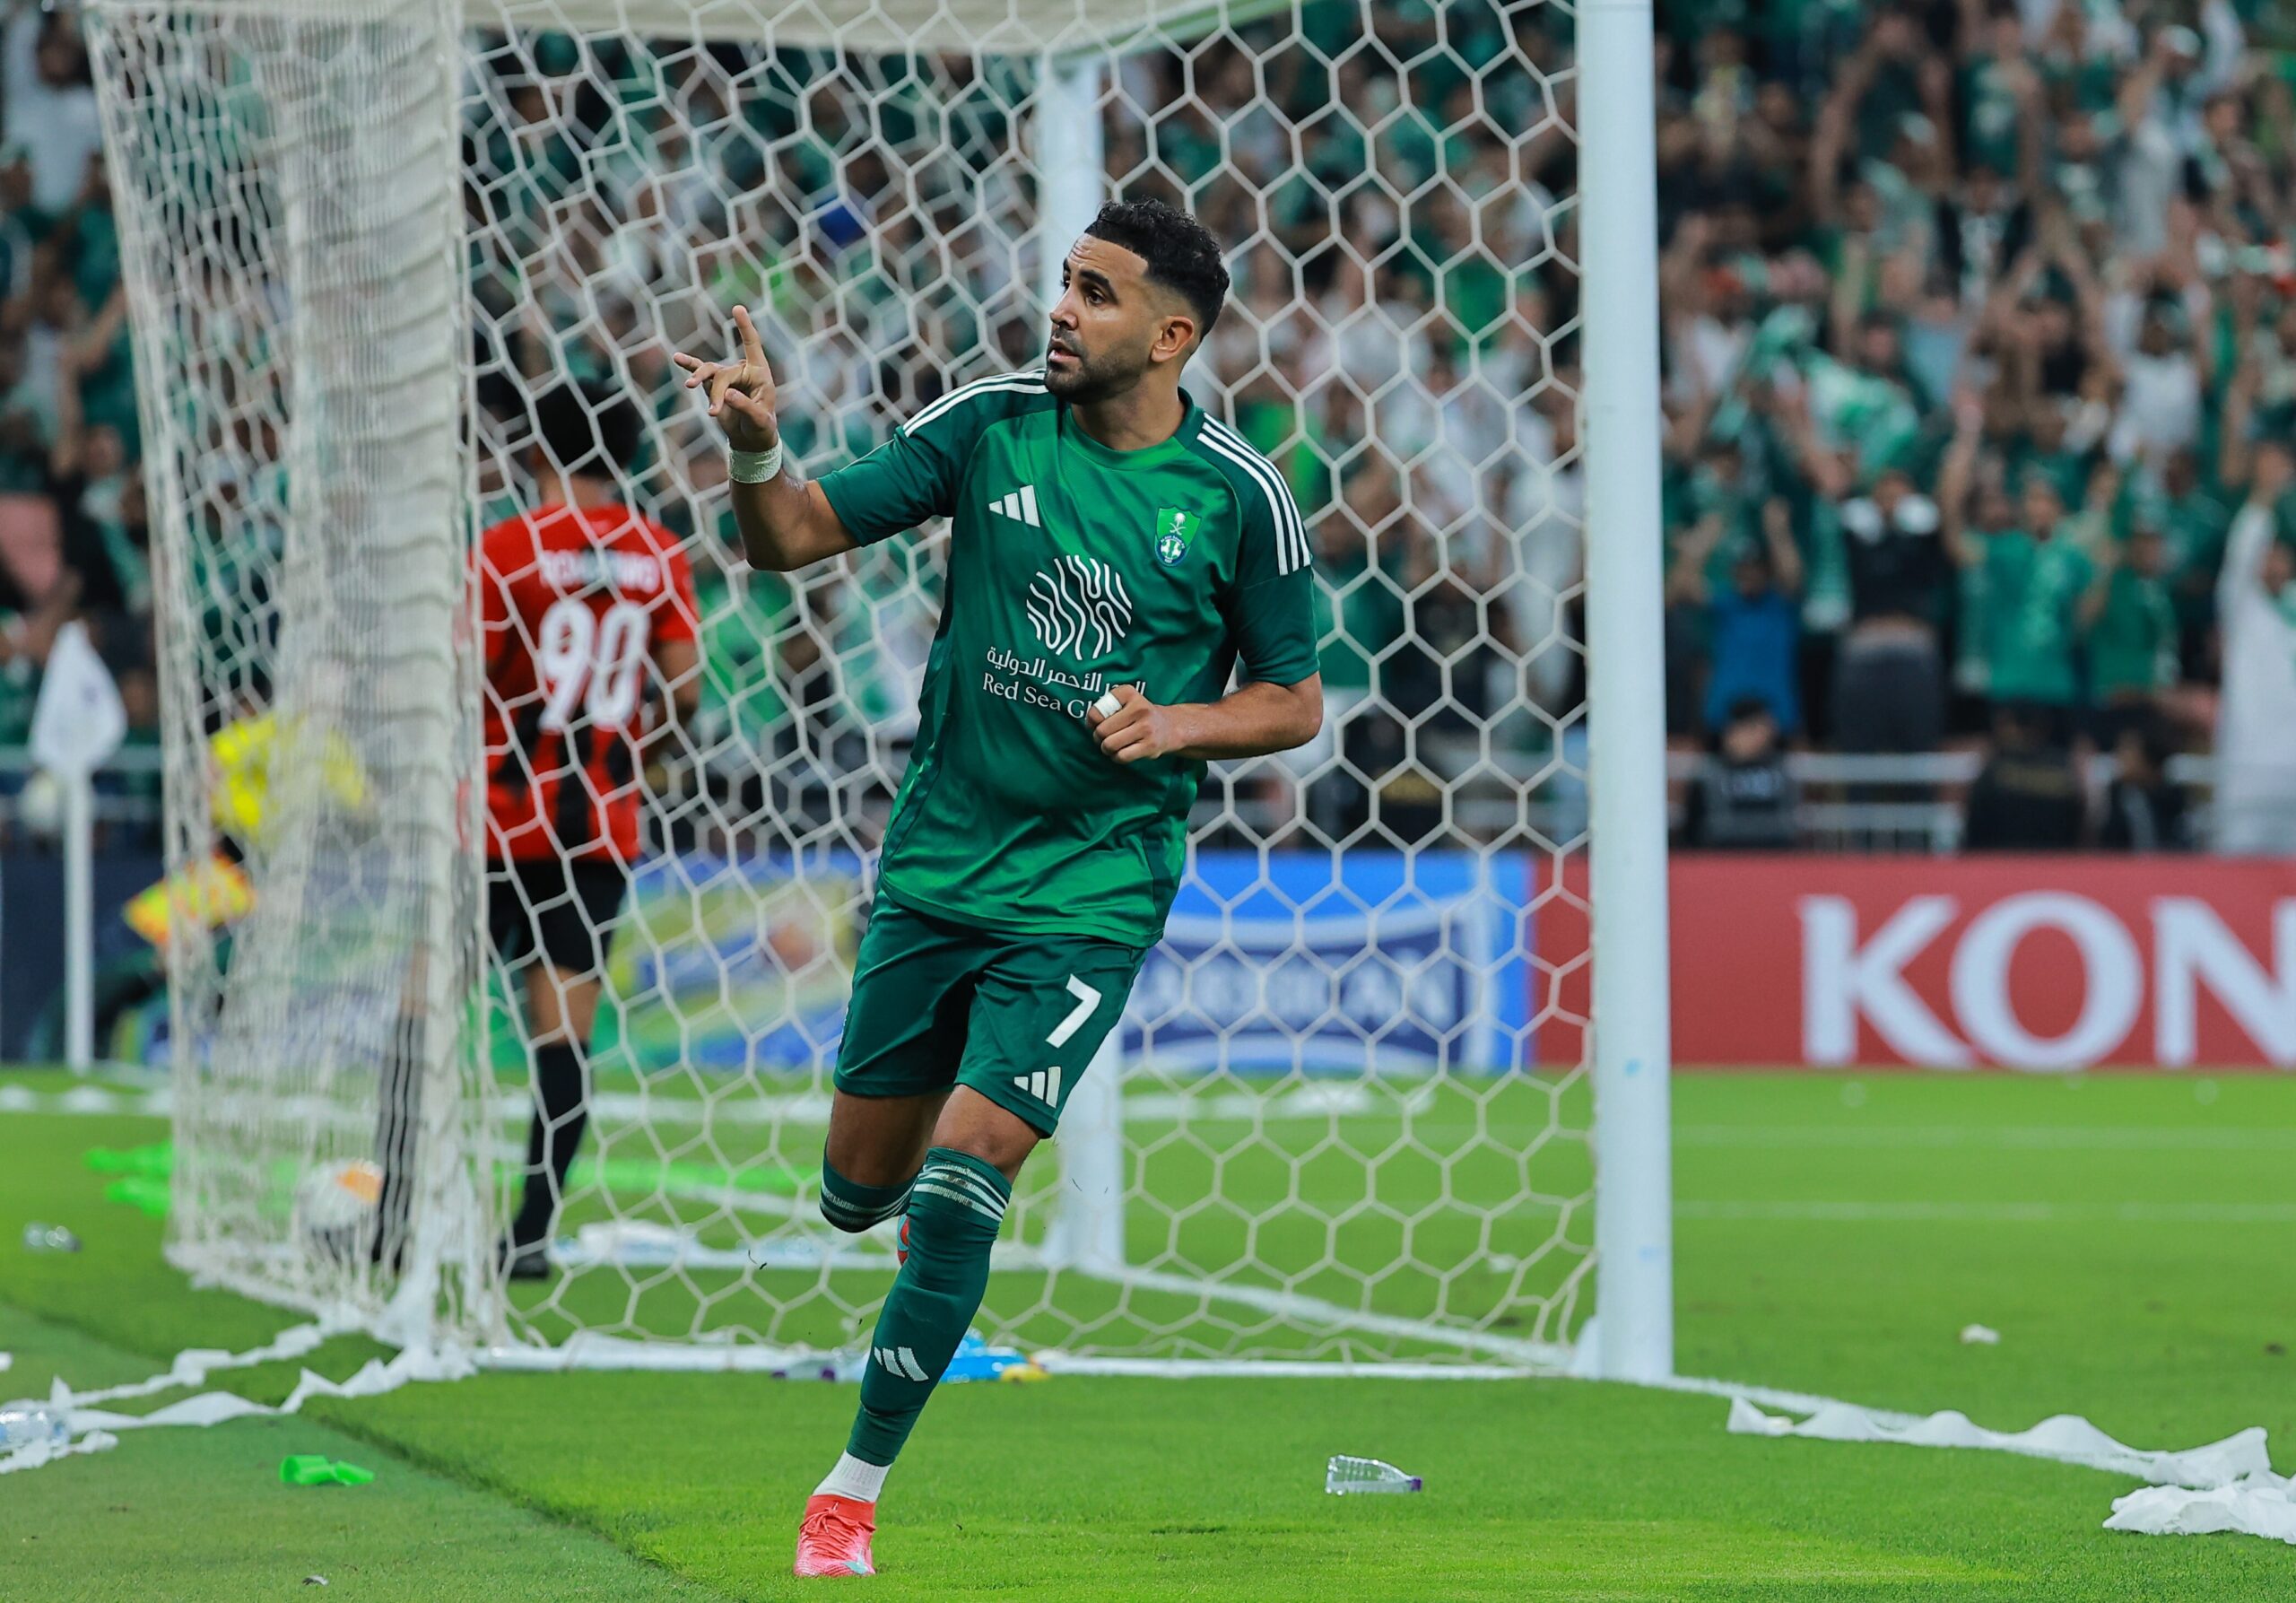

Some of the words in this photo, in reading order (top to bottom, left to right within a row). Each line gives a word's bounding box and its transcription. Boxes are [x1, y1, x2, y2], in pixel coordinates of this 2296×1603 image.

[540, 598, 651, 731] 90
[987, 646, 1046, 678] الدولية
[983, 673, 1019, 701] Red
[1023, 686, 1061, 710] Sea
[1042, 670, 1102, 693] الأحمر
[1045, 973, 1102, 1049] 7
